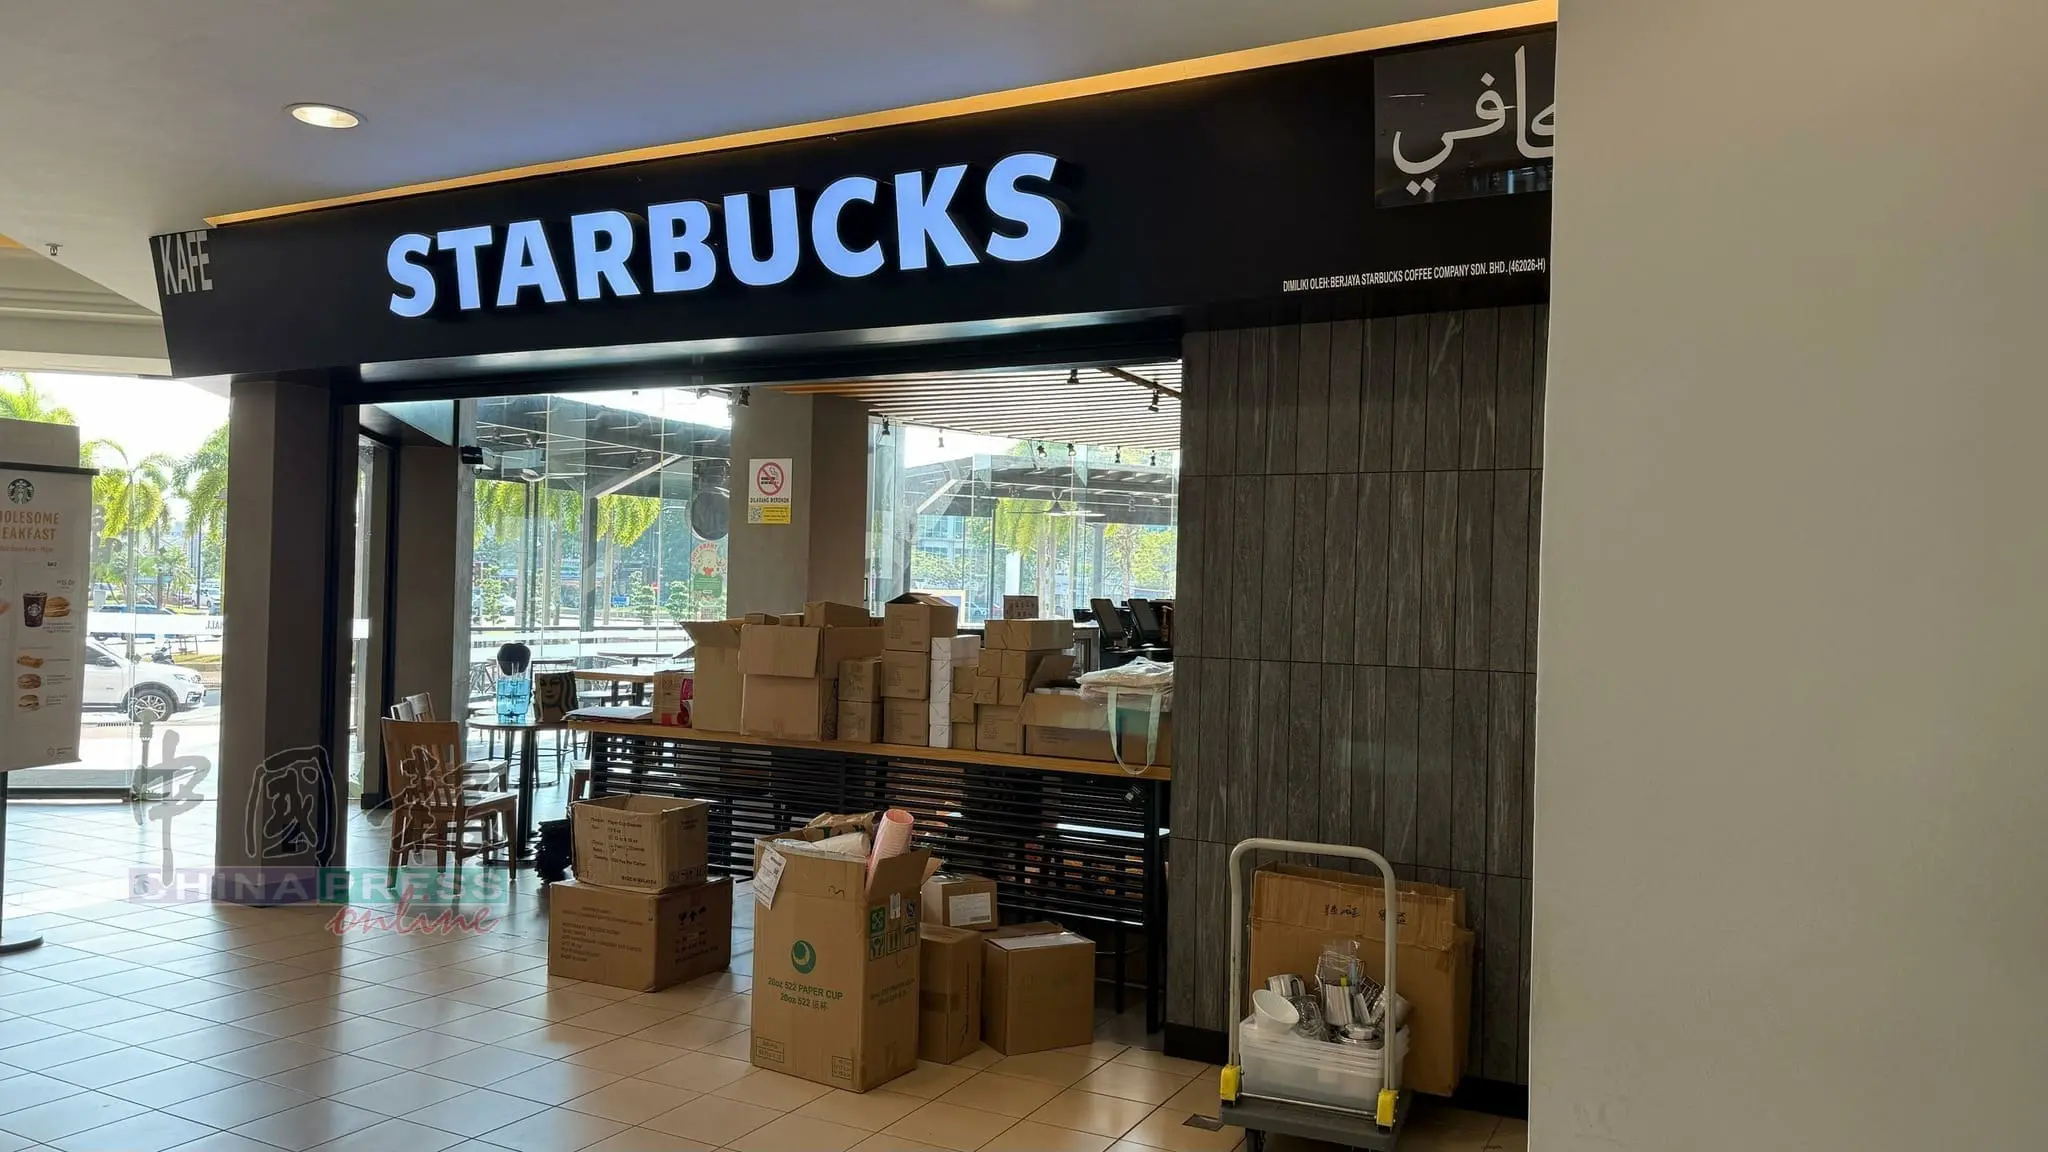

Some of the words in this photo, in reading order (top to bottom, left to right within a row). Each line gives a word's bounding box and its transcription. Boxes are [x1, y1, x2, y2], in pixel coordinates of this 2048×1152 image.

[387, 151, 1063, 318] STARBUCKS
[159, 230, 213, 295] KAFE
[1283, 279, 1309, 292] DIMILIKI
[1330, 273, 1360, 289] BERJAYA
[1361, 270, 1403, 286] STARBUCKS
[1404, 267, 1433, 282] COFFEE
[1433, 263, 1469, 279] COMPANY
[1470, 262, 1488, 276] SDN.
[1508, 258, 1546, 276] (462026-H)
[0, 526, 57, 541] EAKFAST
[784, 981, 797, 992] 522
[798, 984, 824, 997] PAPER
[826, 990, 843, 1000] CUP
[797, 997, 811, 1007] 522
